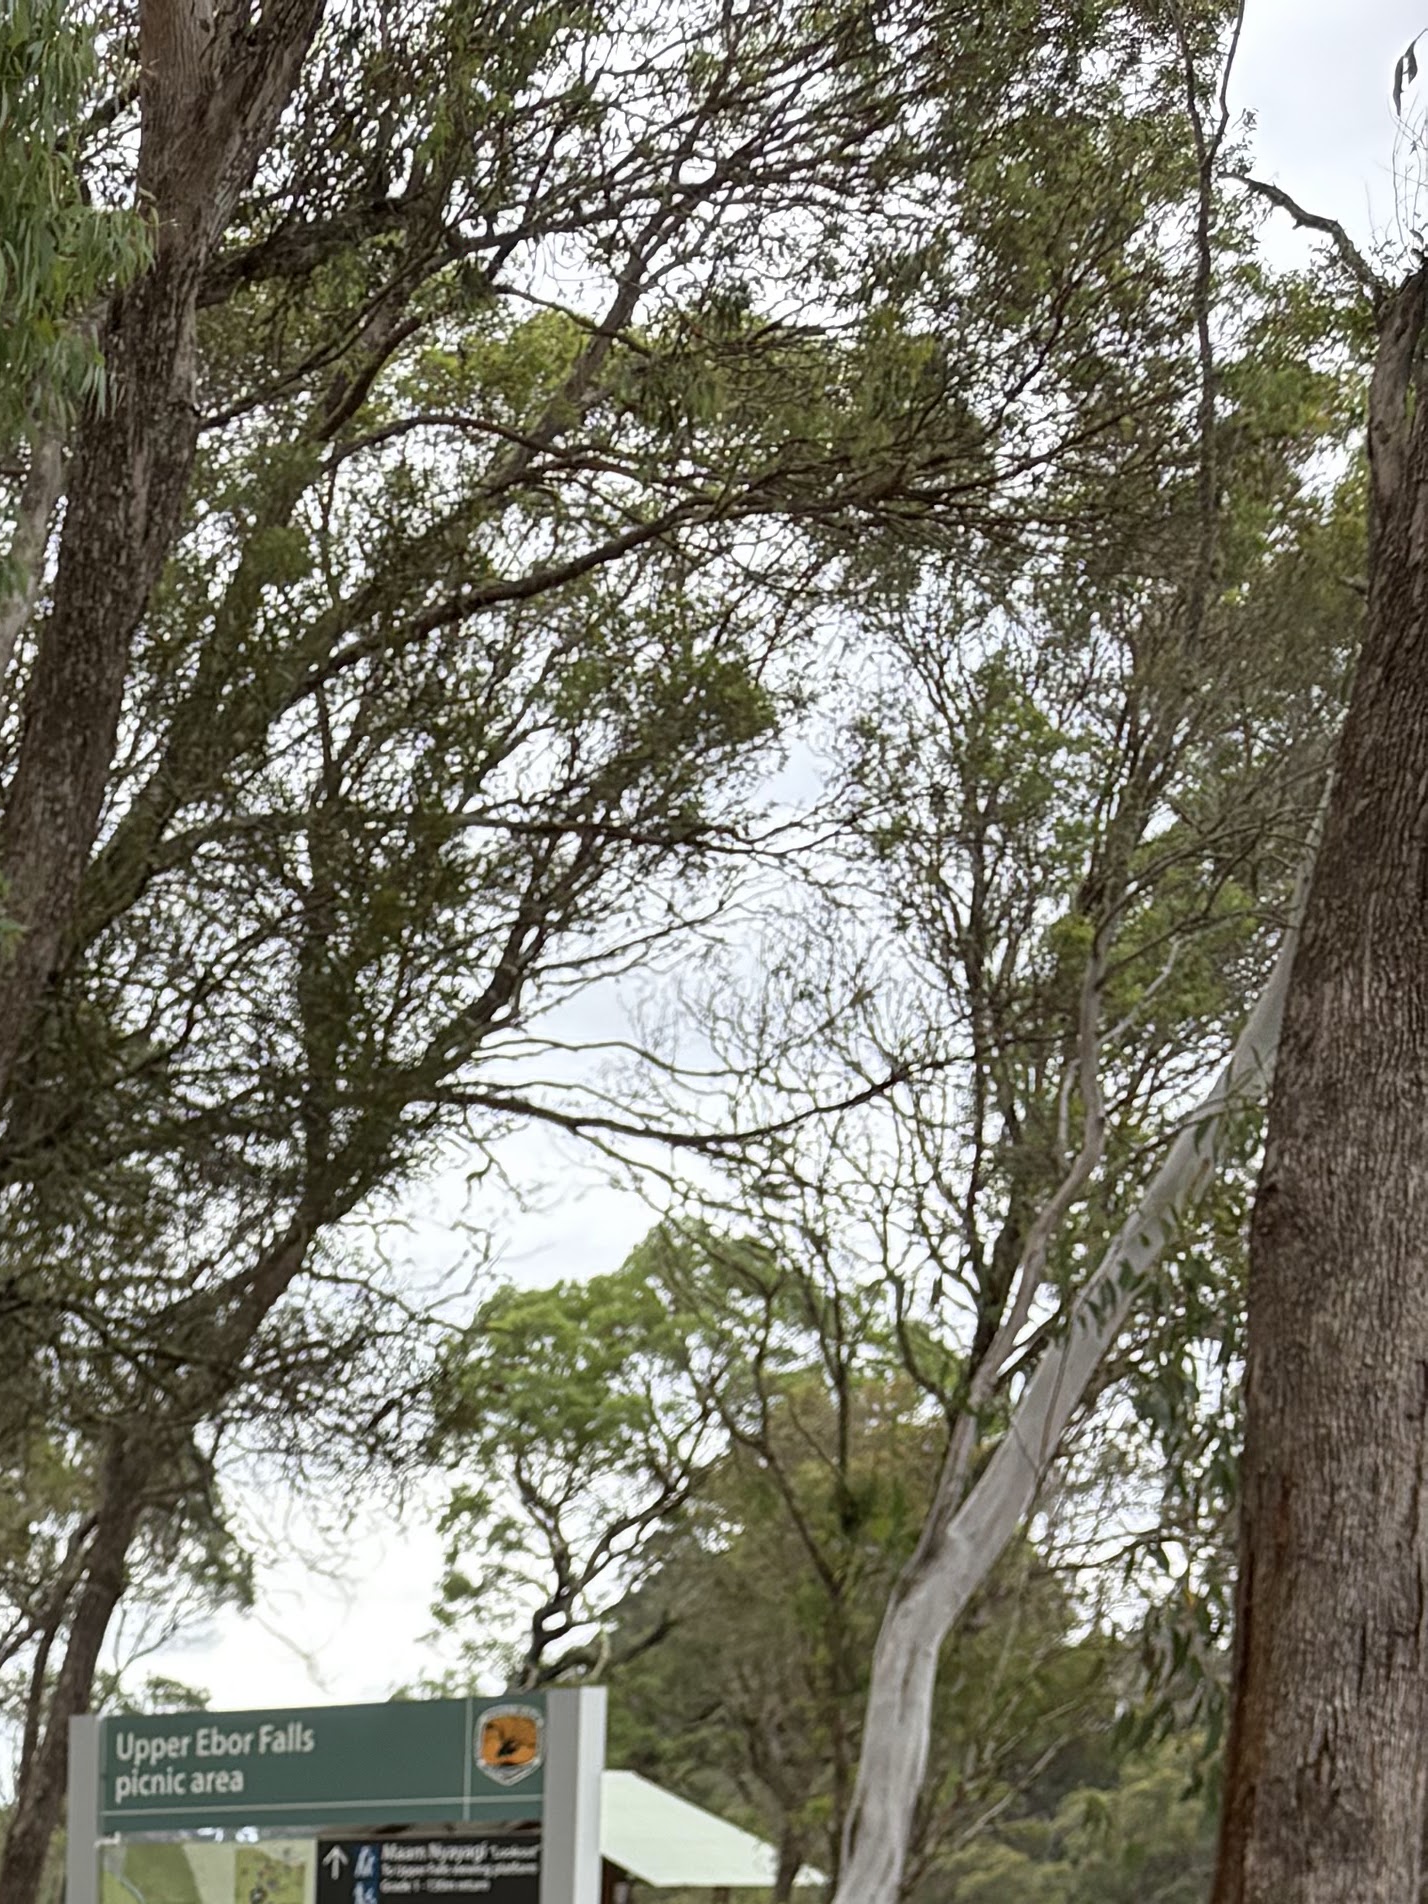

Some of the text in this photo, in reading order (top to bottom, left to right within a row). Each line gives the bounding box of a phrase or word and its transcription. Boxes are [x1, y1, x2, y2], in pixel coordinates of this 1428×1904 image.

[115, 1721, 316, 1767] Upper Ebor Falls
[114, 1765, 245, 1804] picnic area
